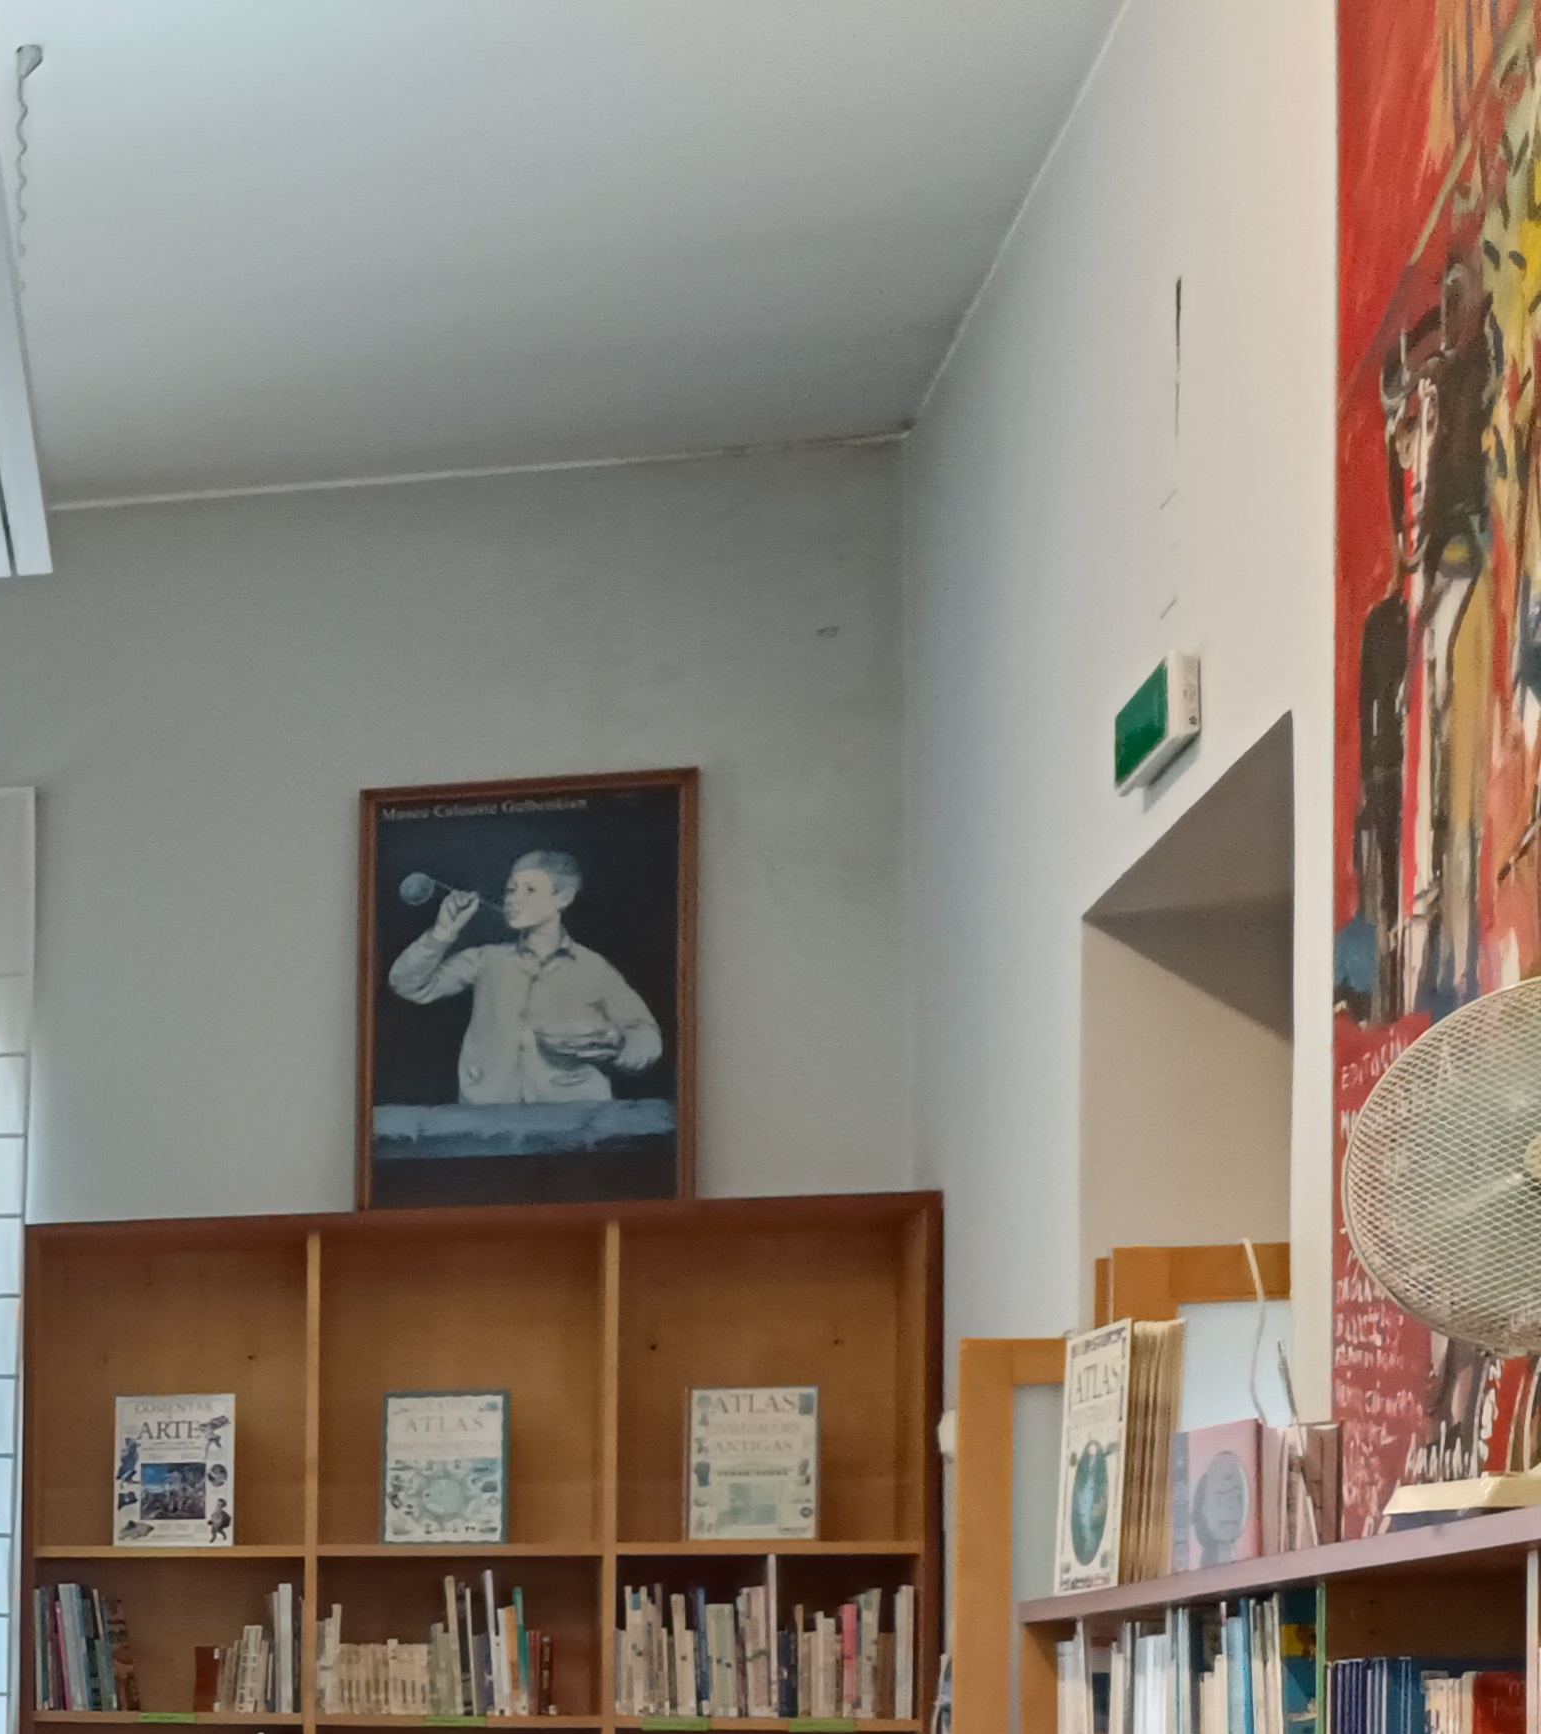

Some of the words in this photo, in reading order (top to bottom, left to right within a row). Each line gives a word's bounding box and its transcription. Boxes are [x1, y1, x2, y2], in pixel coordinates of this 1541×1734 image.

[712, 1392, 796, 1415] ATLAS
[137, 1420, 201, 1440] ARTE
[404, 1415, 485, 1433] ATLAS
